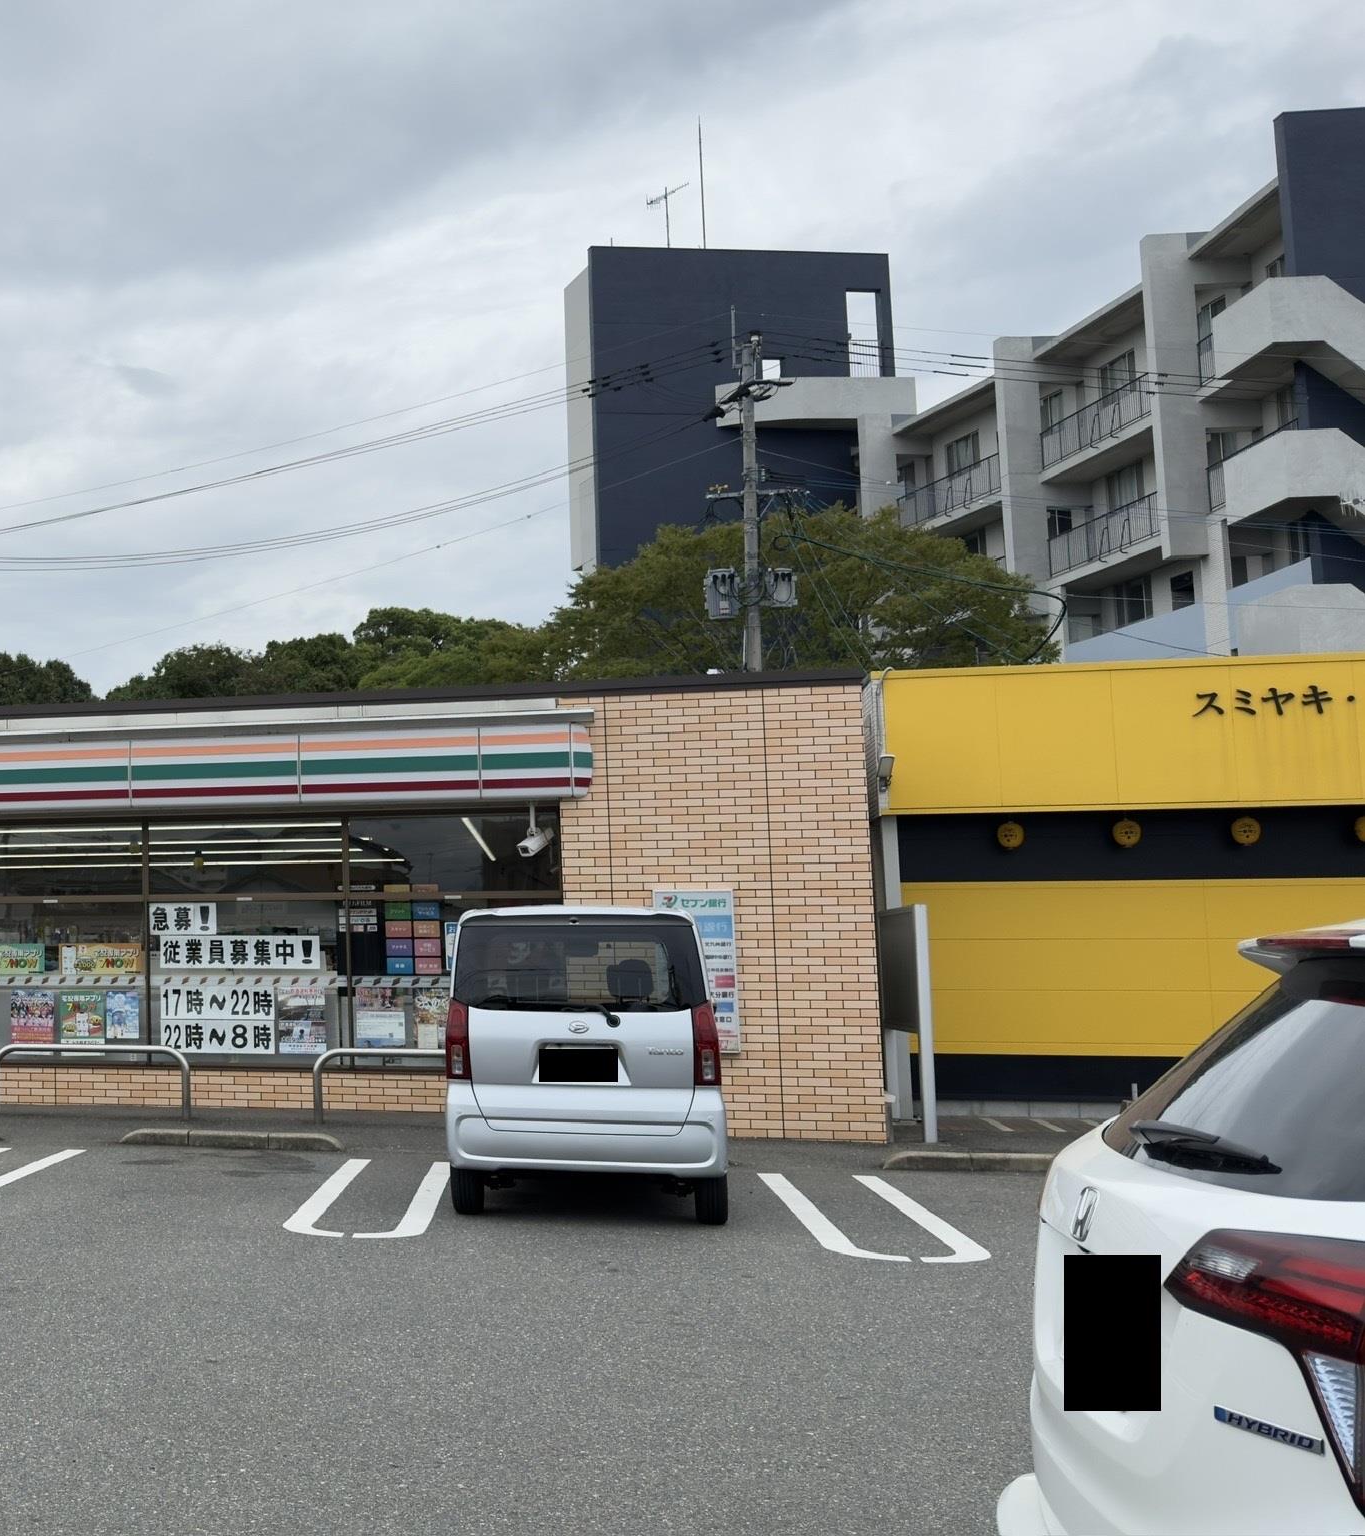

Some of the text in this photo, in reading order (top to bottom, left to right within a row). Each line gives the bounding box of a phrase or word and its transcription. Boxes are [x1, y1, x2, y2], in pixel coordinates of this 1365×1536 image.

[681, 898, 727, 908] セブン銀行
[4, 958, 38, 969] 7NOW
[100, 958, 134, 969] 7NOW
[1228, 1412, 1314, 1450] HYBRID
